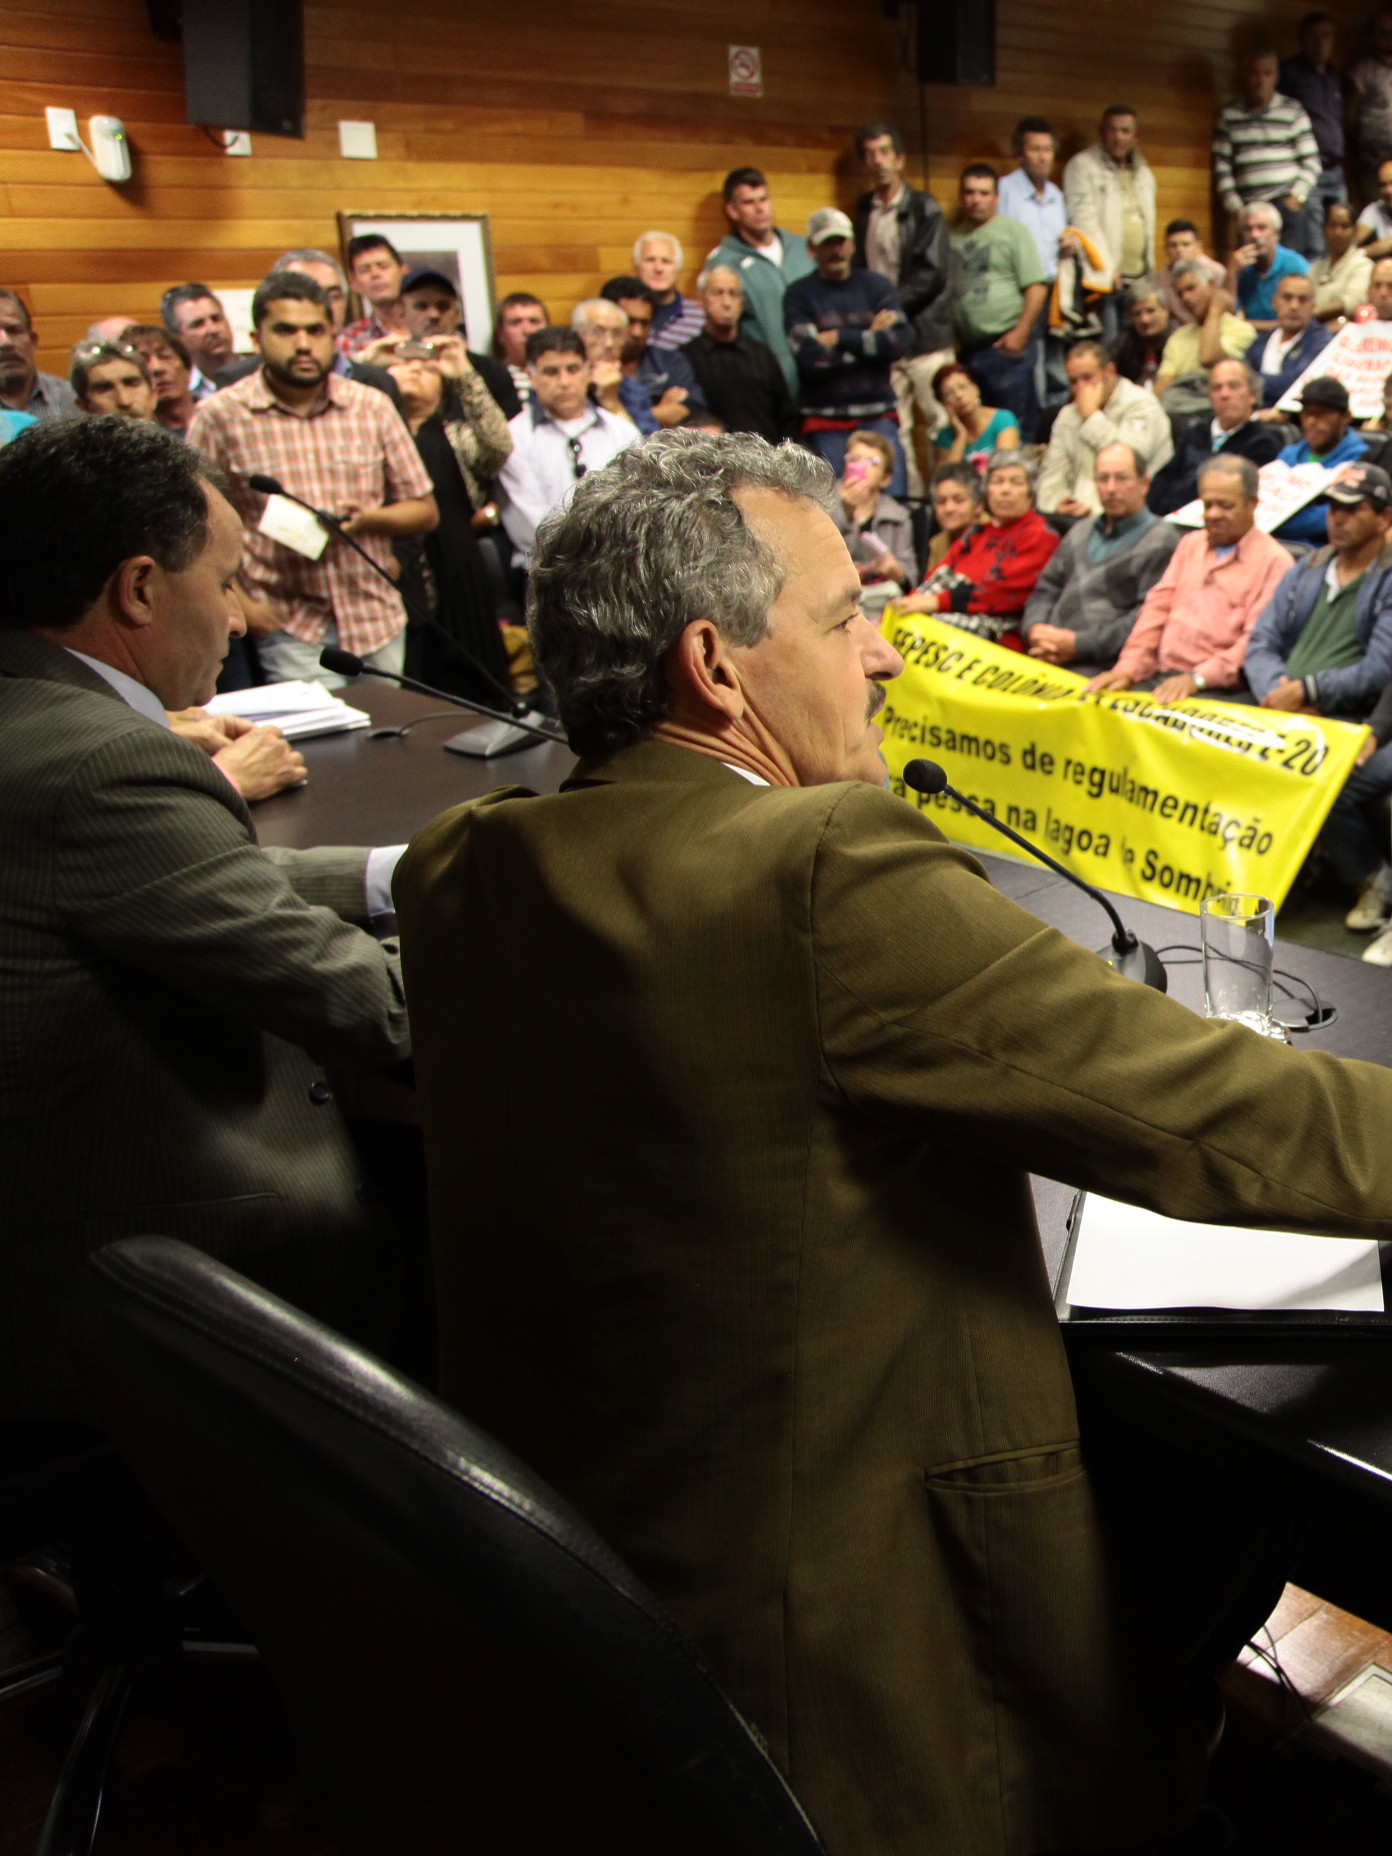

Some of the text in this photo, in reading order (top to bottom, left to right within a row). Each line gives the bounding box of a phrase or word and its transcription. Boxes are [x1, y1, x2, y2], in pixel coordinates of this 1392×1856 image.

[883, 705, 1274, 855] Precisamos de regulamentação
[1006, 803, 1037, 833] na
[1045, 808, 1111, 858] lagoa
